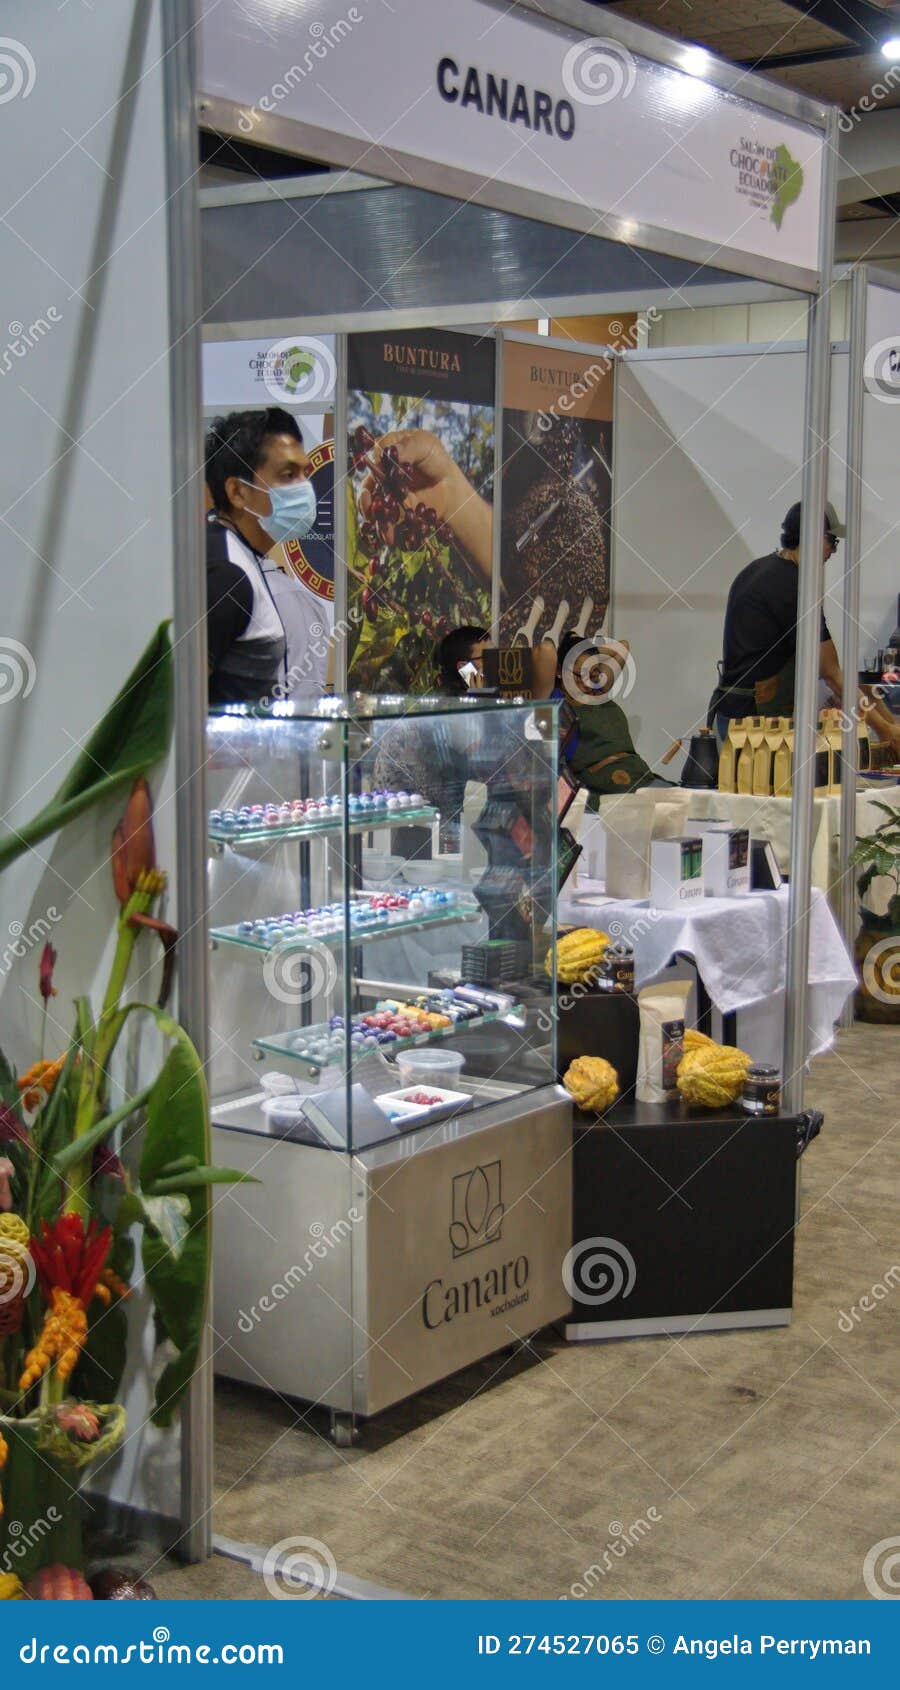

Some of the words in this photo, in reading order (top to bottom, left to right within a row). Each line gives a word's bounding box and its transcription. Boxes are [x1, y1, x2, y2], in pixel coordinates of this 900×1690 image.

[436, 57, 576, 141] CANARO
[383, 343, 461, 373] BUNTURA
[422, 1255, 529, 1330] Canaro
